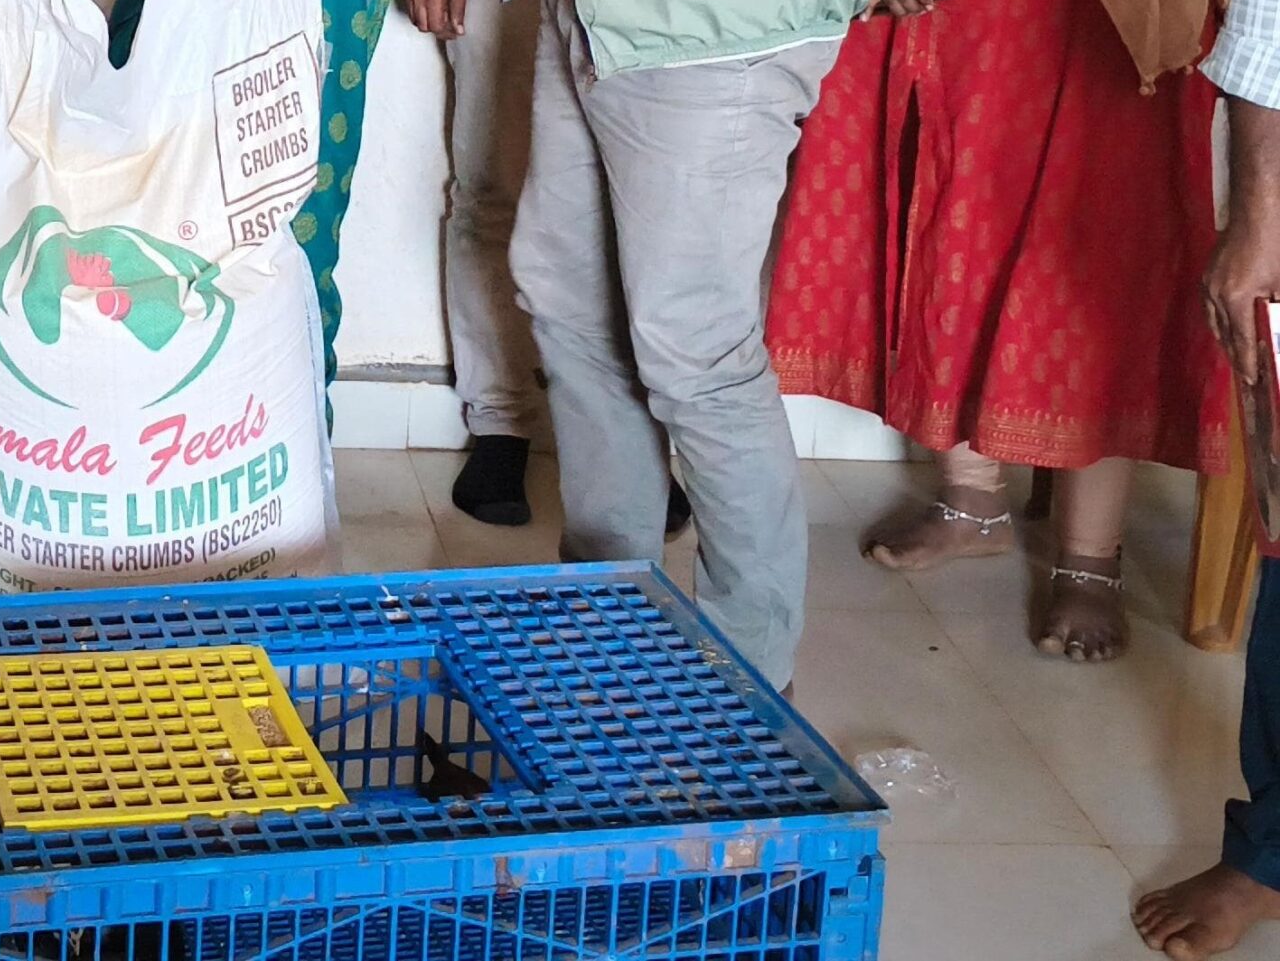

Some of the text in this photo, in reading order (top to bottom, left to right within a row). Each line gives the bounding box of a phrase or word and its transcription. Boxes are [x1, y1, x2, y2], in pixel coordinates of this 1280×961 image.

[232, 56, 297, 107] BROILER
[236, 91, 303, 142] STARTER
[240, 127, 309, 179] CRUMBS
[138, 393, 270, 486] Feeds
[126, 441, 290, 537] LIMITED
[20, 532, 105, 573] STARTER
[111, 536, 195, 573] CRUMBS
[202, 495, 283, 564] (BSC2250)
